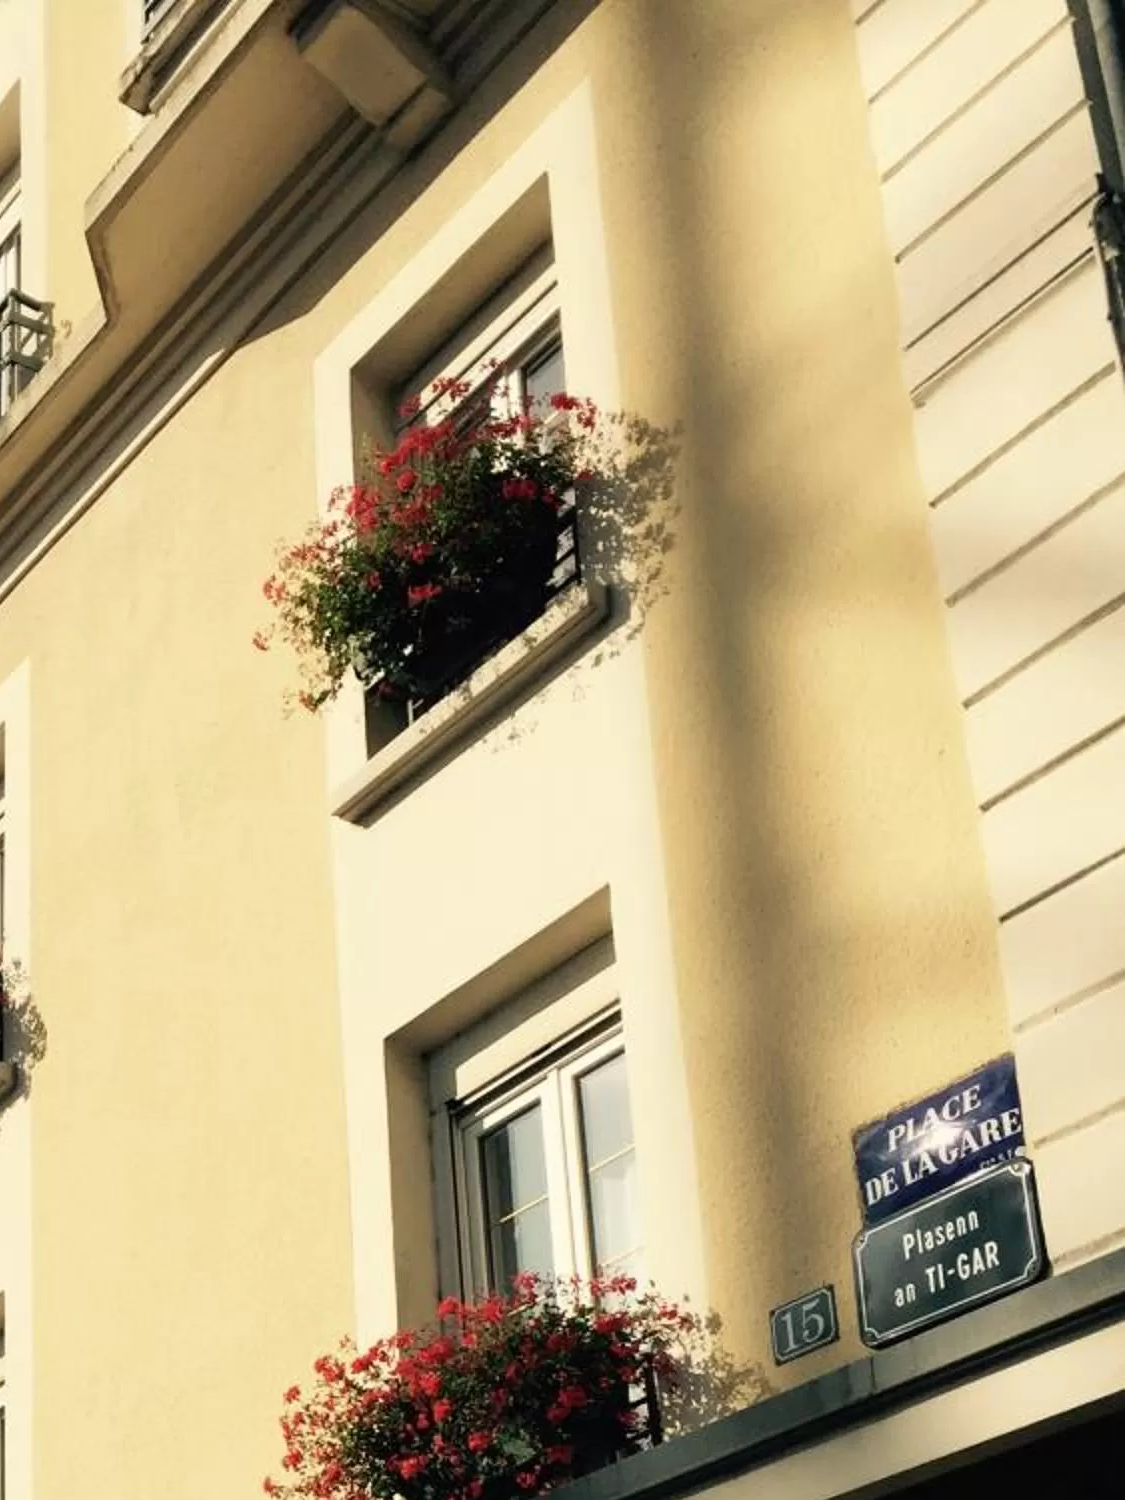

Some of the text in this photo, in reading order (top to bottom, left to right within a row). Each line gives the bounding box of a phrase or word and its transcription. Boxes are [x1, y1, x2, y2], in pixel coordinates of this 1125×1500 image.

[887, 1084, 982, 1152] PLACE
[864, 1167, 899, 1206] DE
[902, 1156, 939, 1187] LA
[938, 1107, 1022, 1165] GARE
[901, 1210, 979, 1261] Plasenn
[893, 1240, 1000, 1308] an TI-GAR
[780, 1299, 824, 1352] 15
